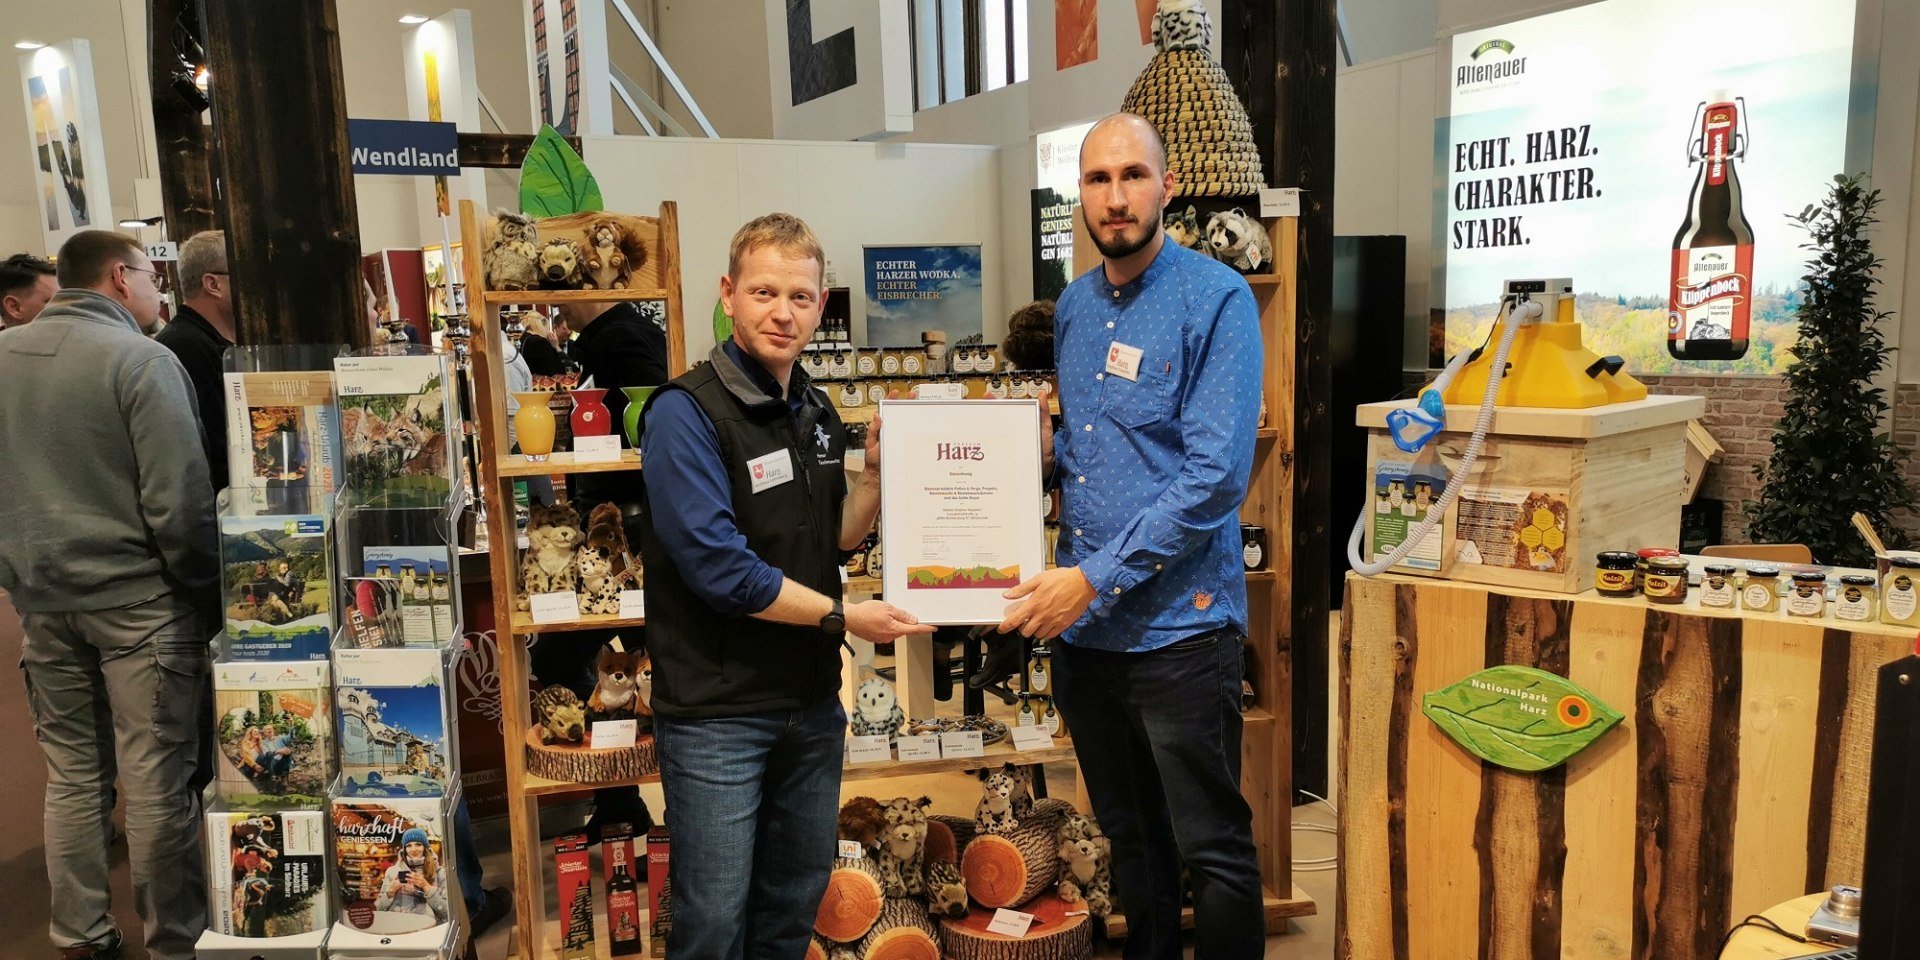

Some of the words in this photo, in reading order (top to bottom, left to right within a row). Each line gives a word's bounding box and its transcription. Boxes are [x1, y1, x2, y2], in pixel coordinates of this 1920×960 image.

[1456, 56, 1527, 89] Altenauer
[351, 147, 459, 168] Wendland
[1455, 136, 1516, 173] ECHT.
[1526, 124, 1599, 164] HARZ.
[1454, 167, 1602, 212] CHARAKTER.
[1041, 203, 1073, 219] NATÜRLI
[1041, 218, 1073, 232] GENIESS
[1453, 216, 1531, 250] STARK.
[1041, 231, 1073, 246] NATÜRLI
[1041, 247, 1055, 260] GIN
[876, 260, 916, 270] ECHTER
[876, 271, 917, 280] HARZER
[919, 270, 960, 279] WODKA.
[877, 281, 917, 290] ECHTER
[877, 291, 942, 300] EISBRECHER.
[1681, 276, 1740, 305] Klippenbock
[231, 381, 242, 401] Harz
[343, 385, 364, 394] Harz
[937, 442, 985, 461] Harz
[322, 466, 333, 493] 2020
[350, 609, 371, 648] HELFEN
[343, 676, 362, 685] Harz
[1471, 679, 1548, 703] Nationalpark
[1520, 702, 1548, 716] Harz
[339, 815, 405, 843] harzhaft
[292, 863, 301, 893] PARADIES
[301, 862, 309, 894] URLAUBS-
